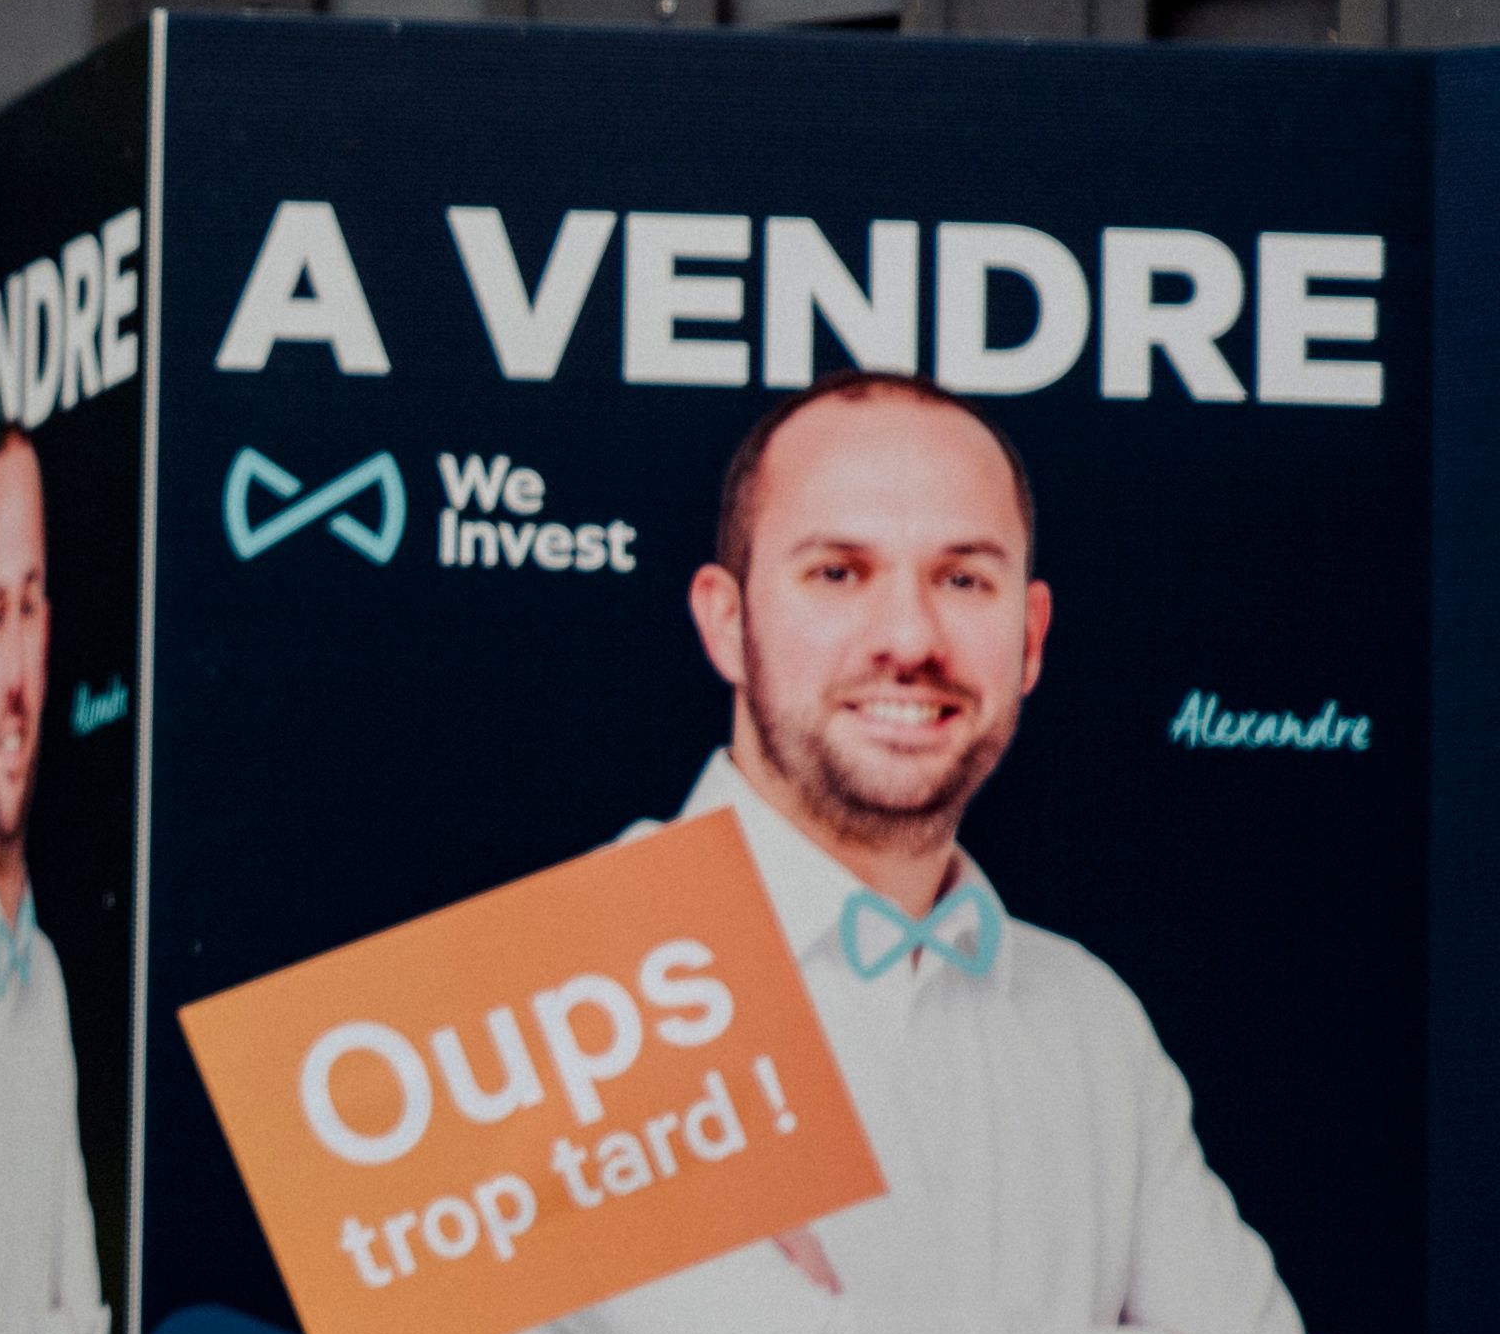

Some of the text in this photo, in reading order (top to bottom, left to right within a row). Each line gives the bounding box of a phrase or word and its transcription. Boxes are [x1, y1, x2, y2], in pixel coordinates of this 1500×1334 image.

[215, 200, 1385, 407] A VENDRE
[438, 452, 546, 515] We
[439, 506, 638, 574] Invest
[1169, 689, 1372, 752] Alexandre
[298, 937, 736, 1166] Oups
[339, 1174, 538, 1289] trop
[550, 1069, 748, 1209] tard
